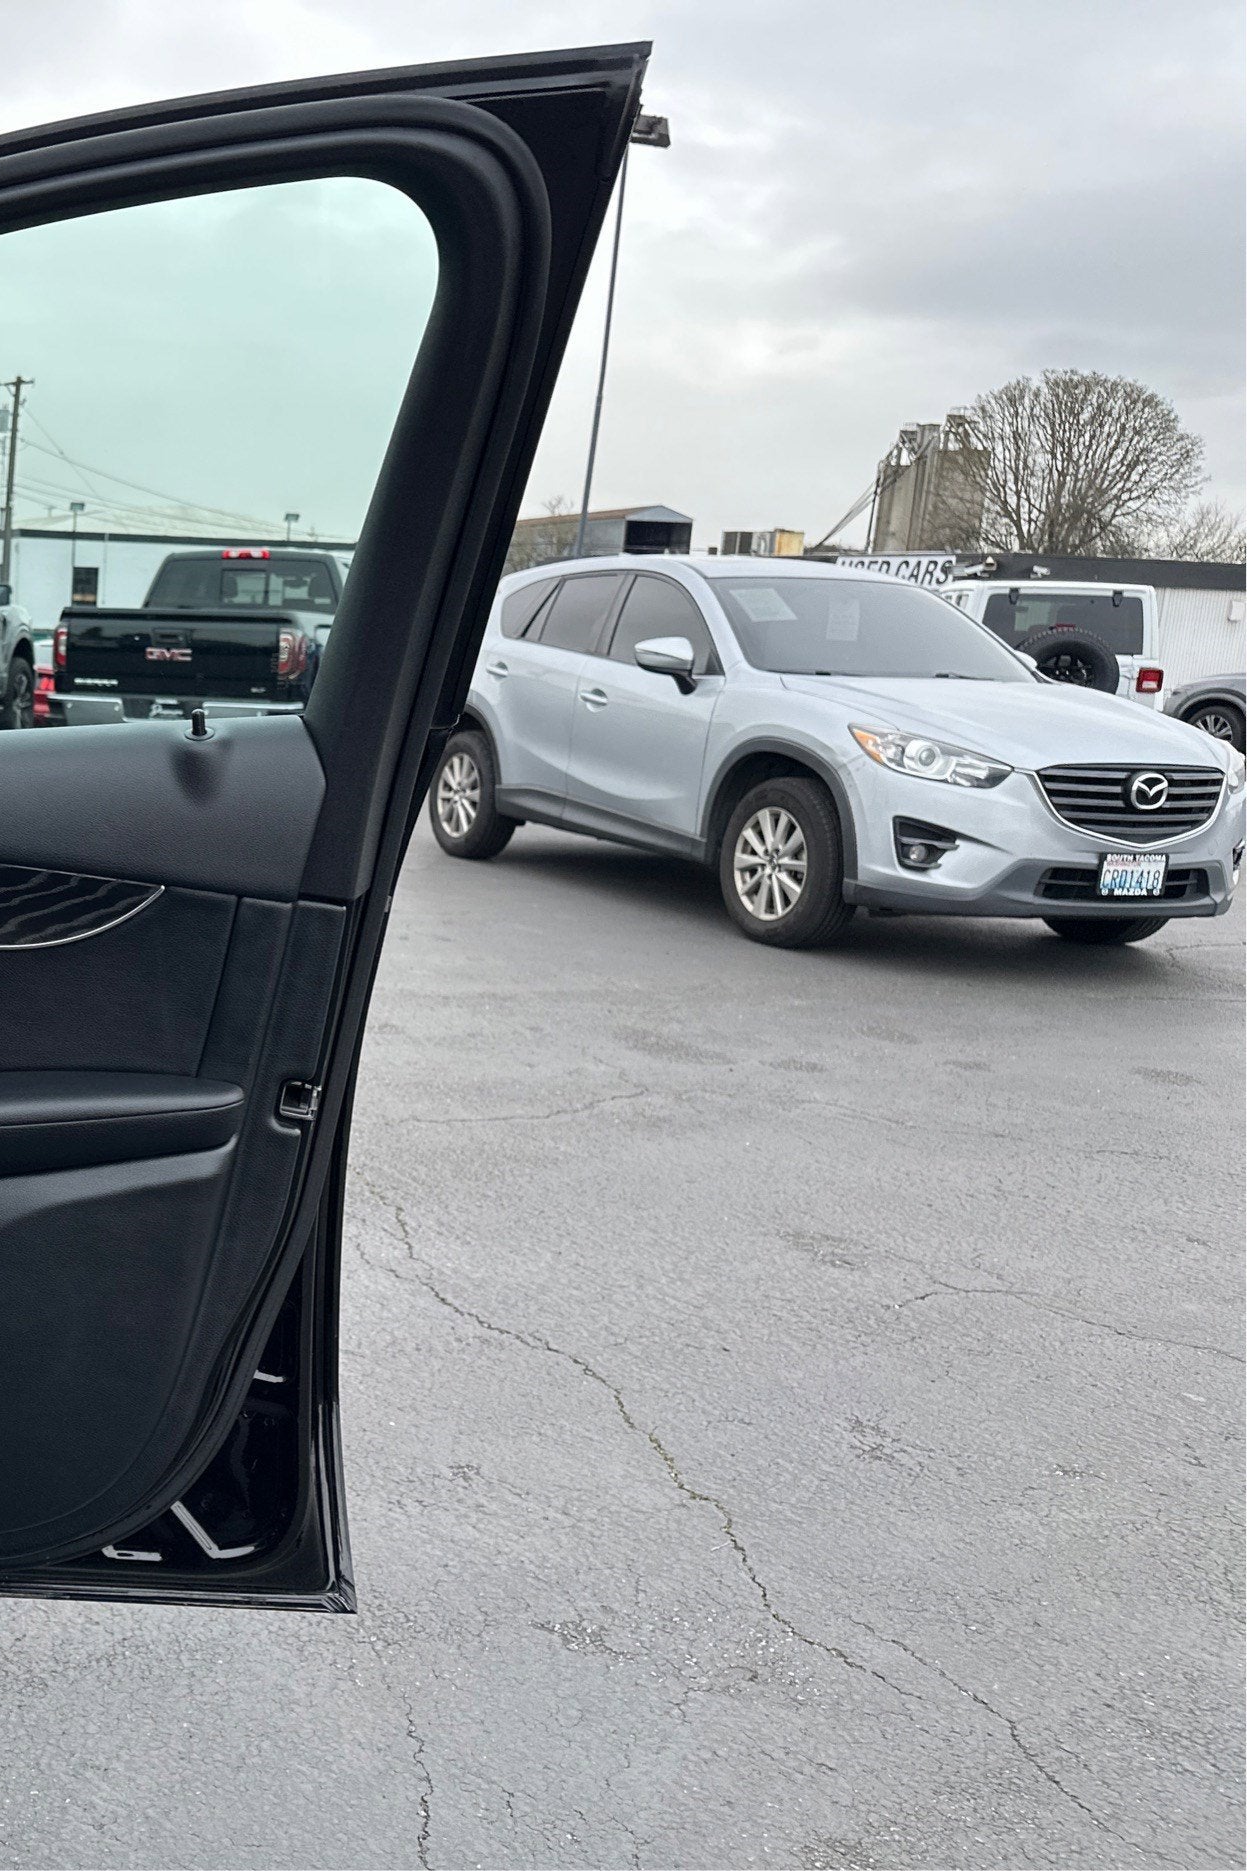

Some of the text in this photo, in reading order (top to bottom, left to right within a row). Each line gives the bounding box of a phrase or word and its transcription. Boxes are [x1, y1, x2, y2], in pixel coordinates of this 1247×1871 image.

[895, 560, 953, 585] CARS
[145, 647, 192, 661] GMC
[1106, 854, 1166, 862] SOUTH TACOMA
[1113, 888, 1148, 896] MAZDA
